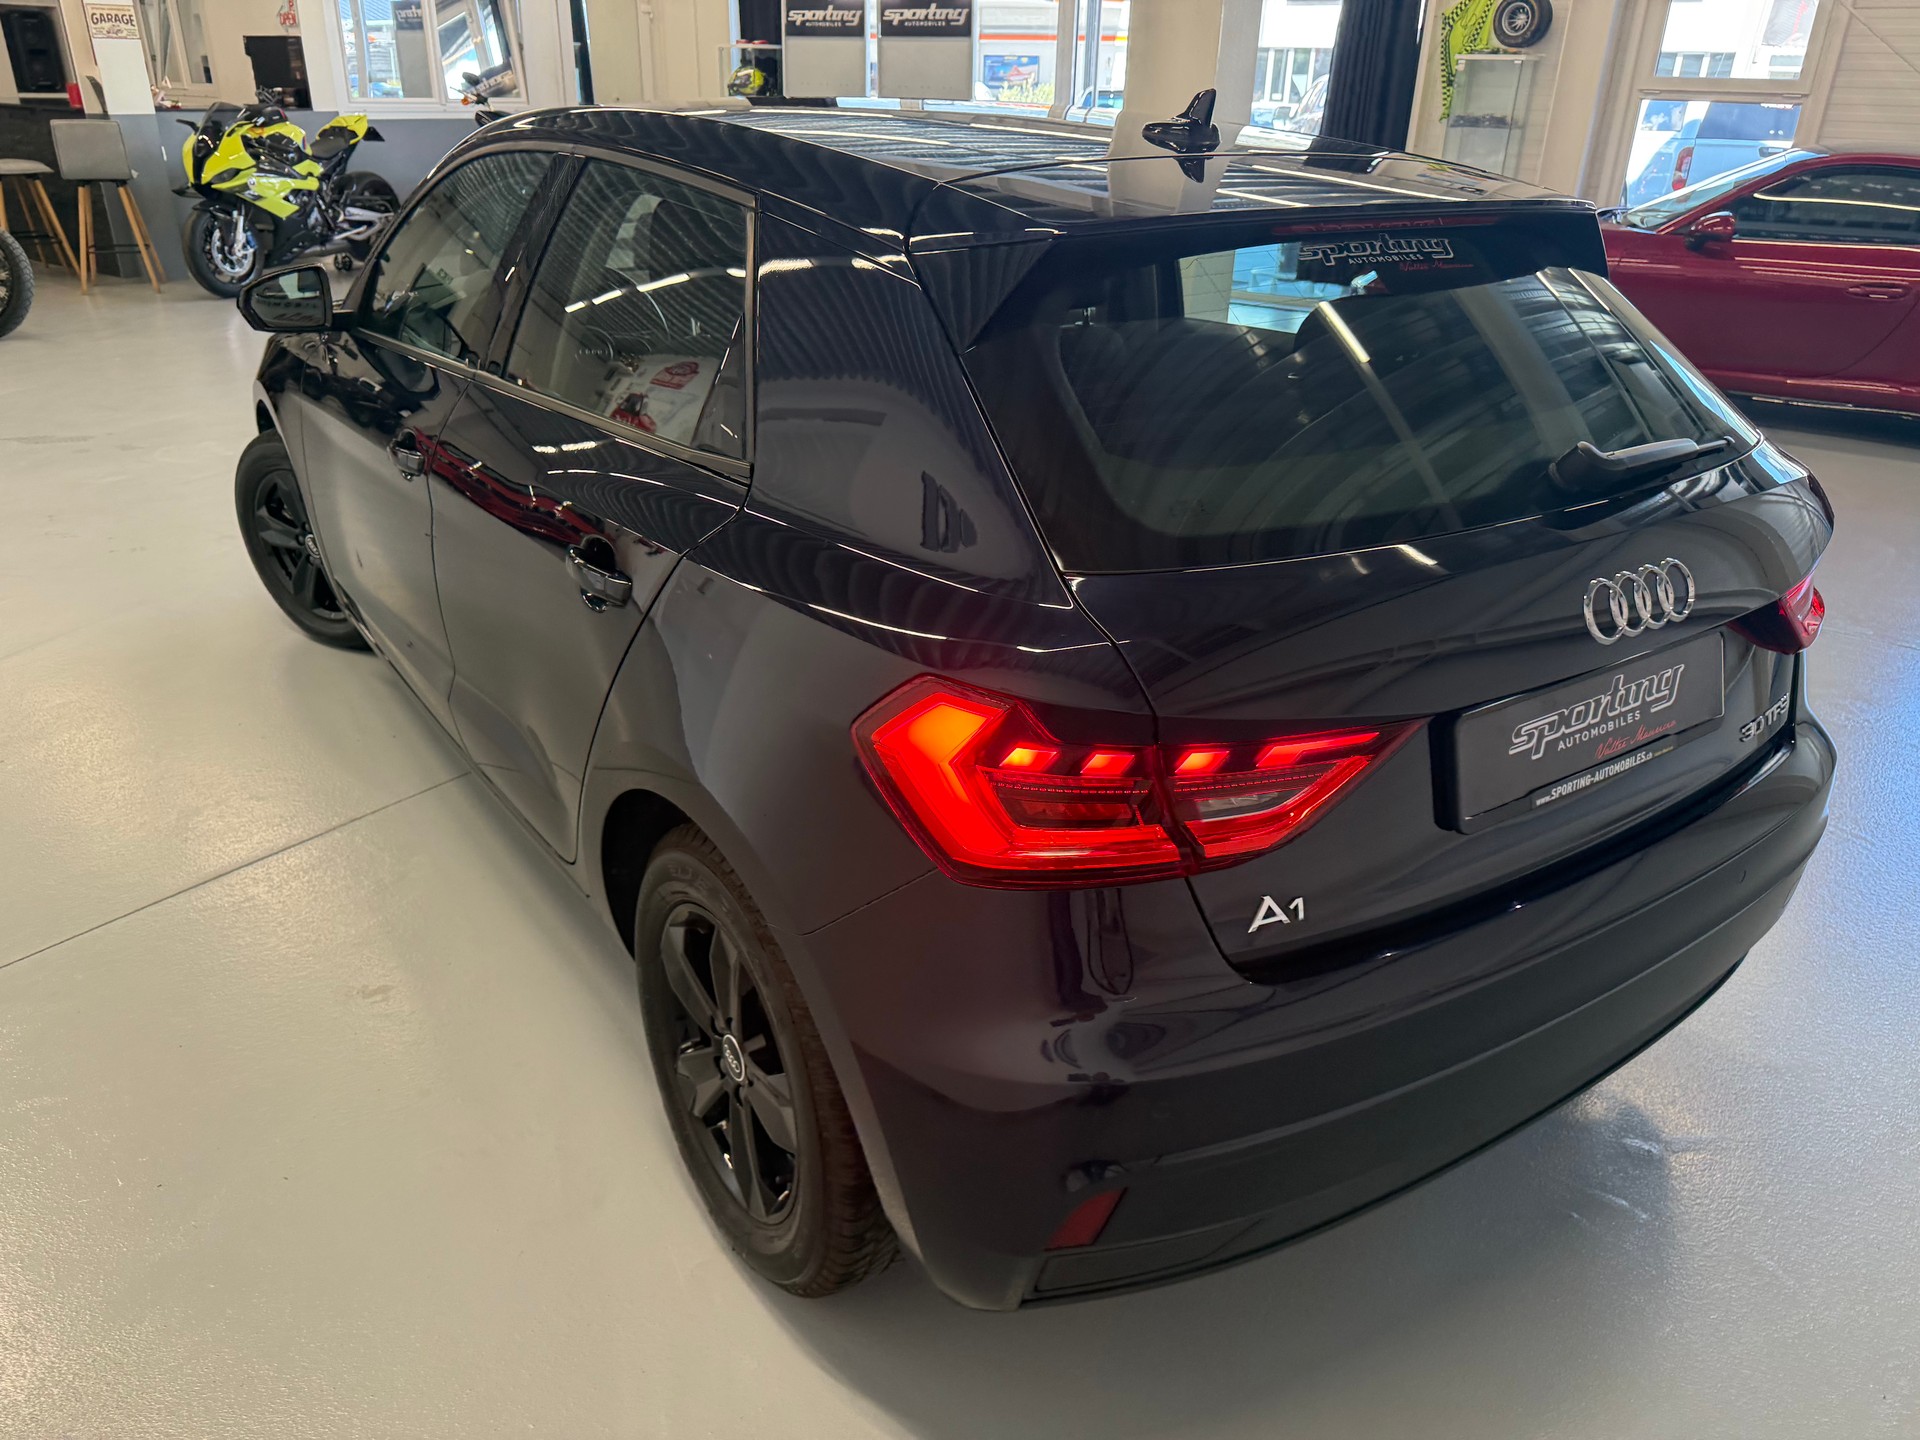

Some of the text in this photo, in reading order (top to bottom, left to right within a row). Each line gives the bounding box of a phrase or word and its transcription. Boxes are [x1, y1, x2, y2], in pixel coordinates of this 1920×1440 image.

[91, 12, 136, 27] GARAGE
[788, 5, 862, 26] sporting
[883, 3, 969, 26] sporting
[1300, 233, 1454, 266] sporting
[1348, 253, 1424, 265] AUTOMOBILES
[1508, 664, 1685, 760] sporting
[1557, 710, 1641, 751] AUTOMOBILES
[1740, 715, 1764, 742] 30
[1247, 895, 1304, 934] A1
